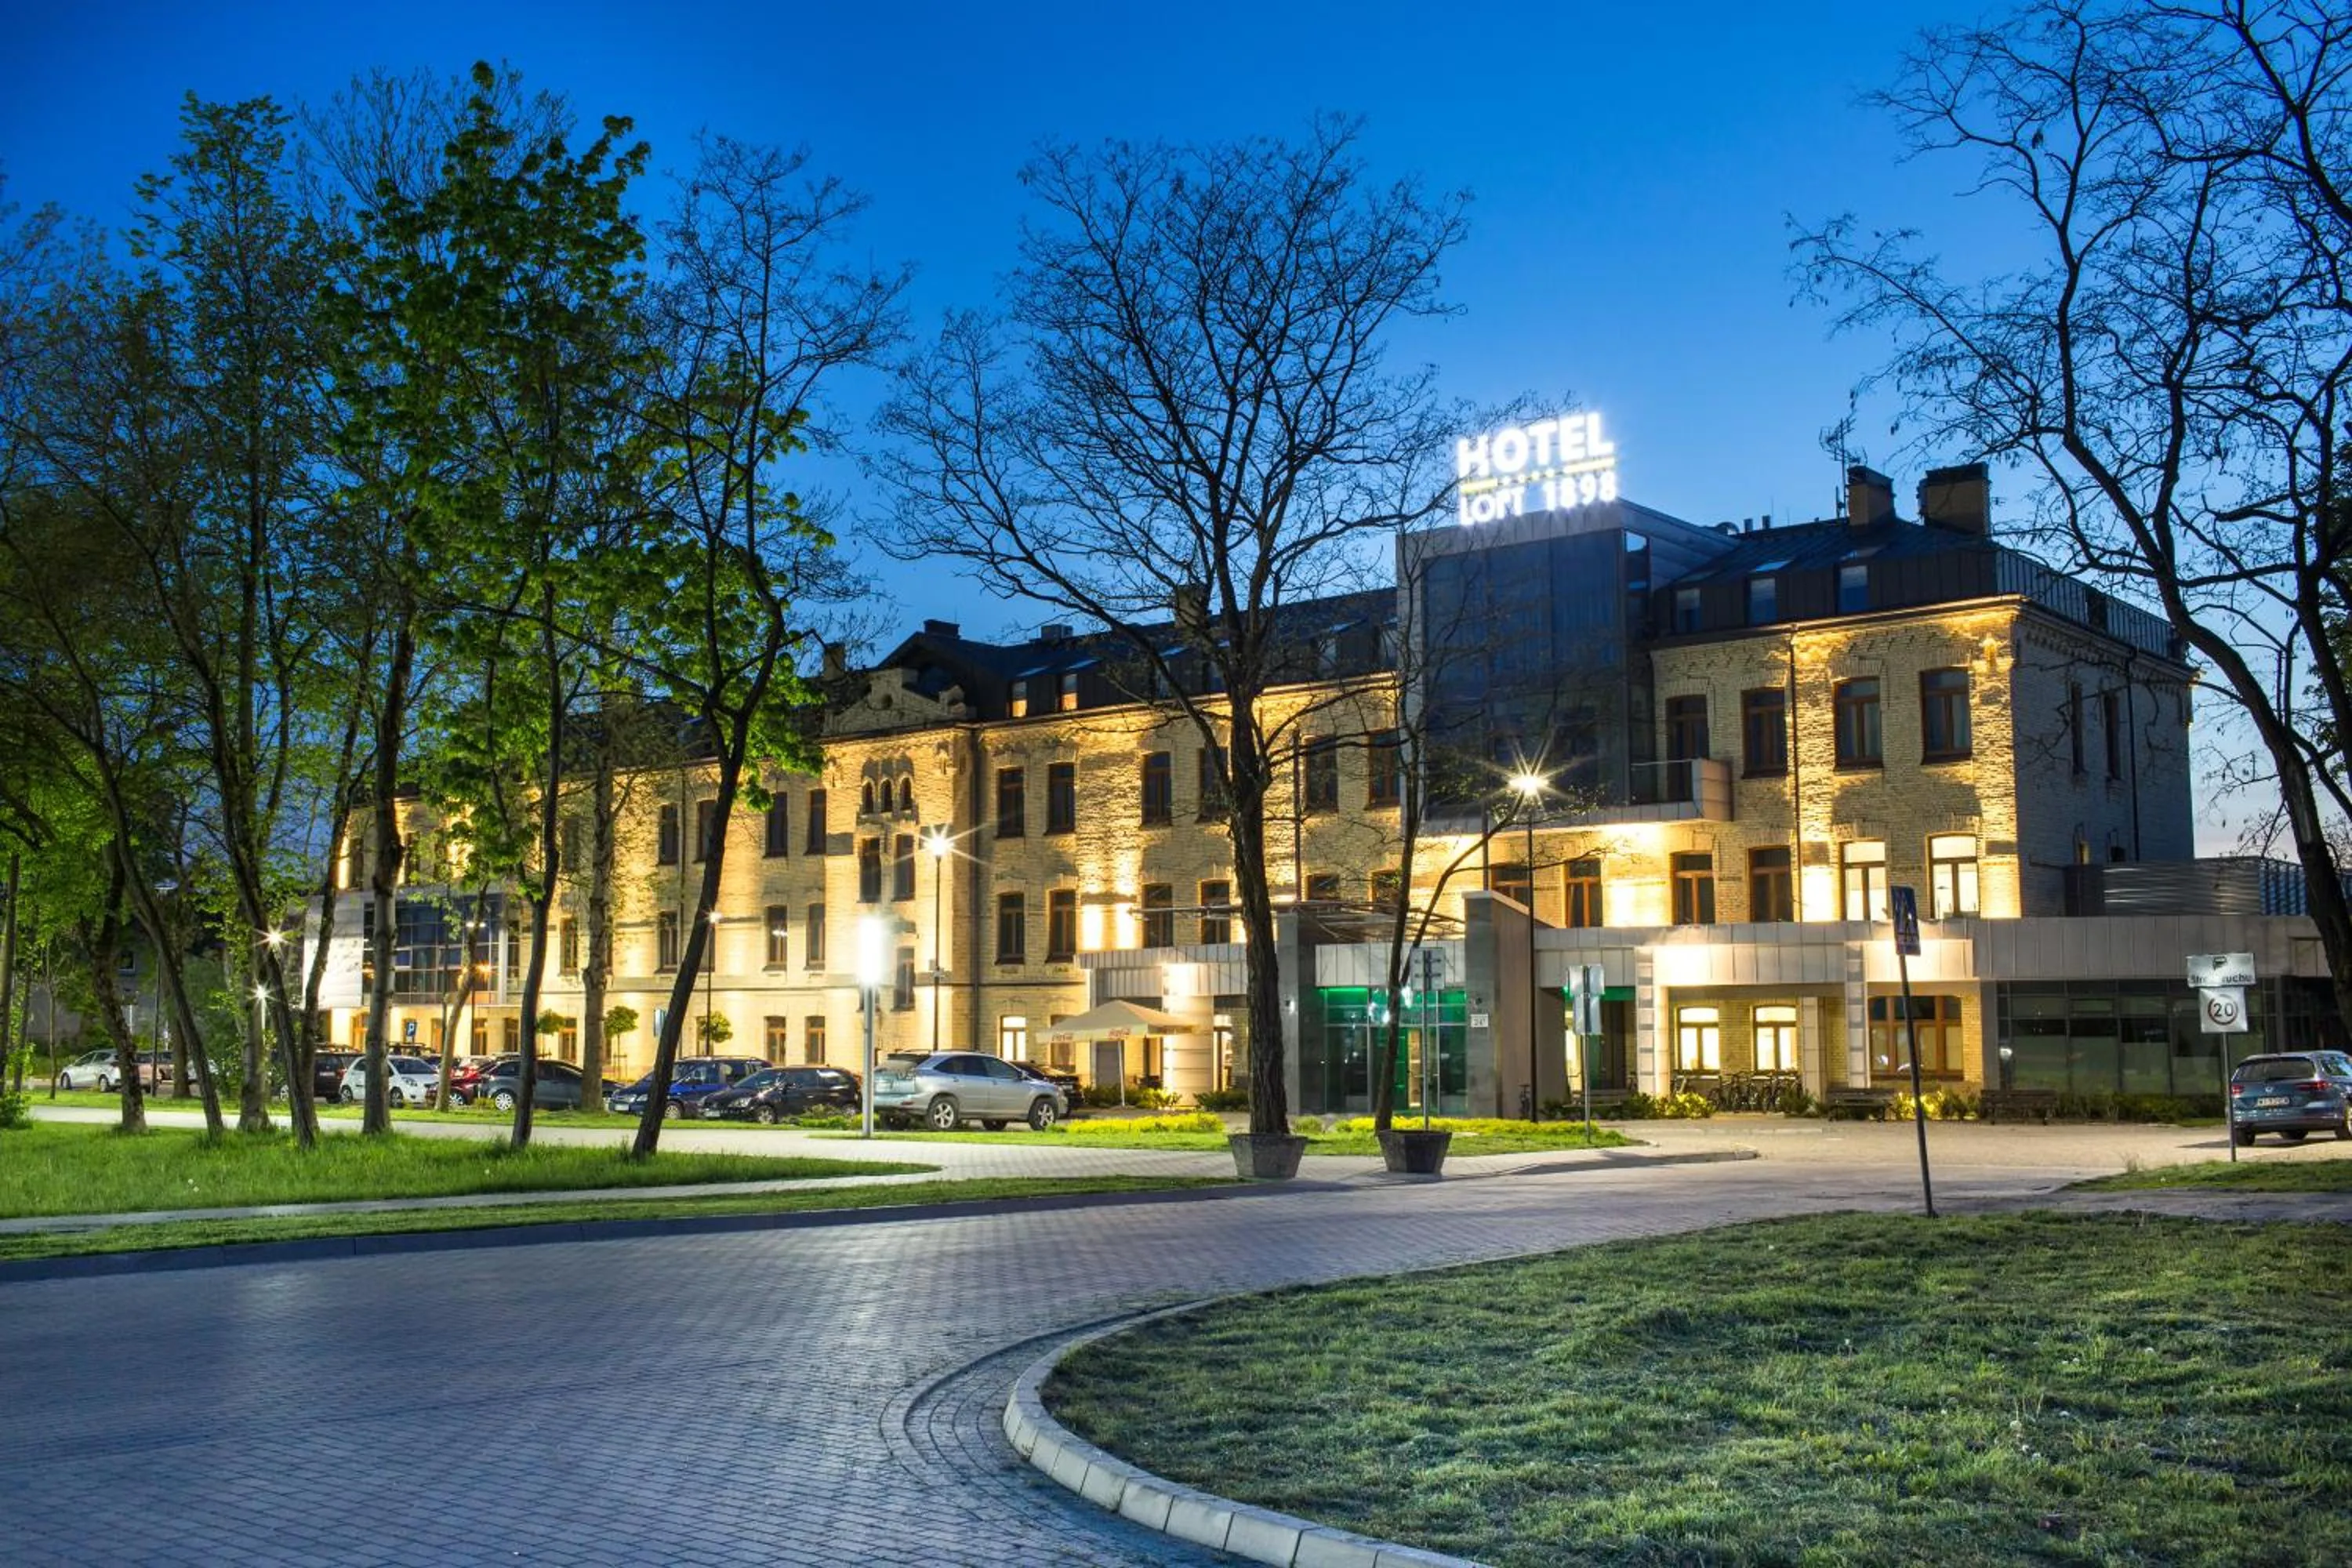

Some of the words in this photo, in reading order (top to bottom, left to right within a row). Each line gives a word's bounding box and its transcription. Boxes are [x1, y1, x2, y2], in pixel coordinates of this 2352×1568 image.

[1457, 412, 1615, 478] HOTEL
[1542, 470, 1618, 511] 1898
[2213, 1003, 2234, 1017] 20
